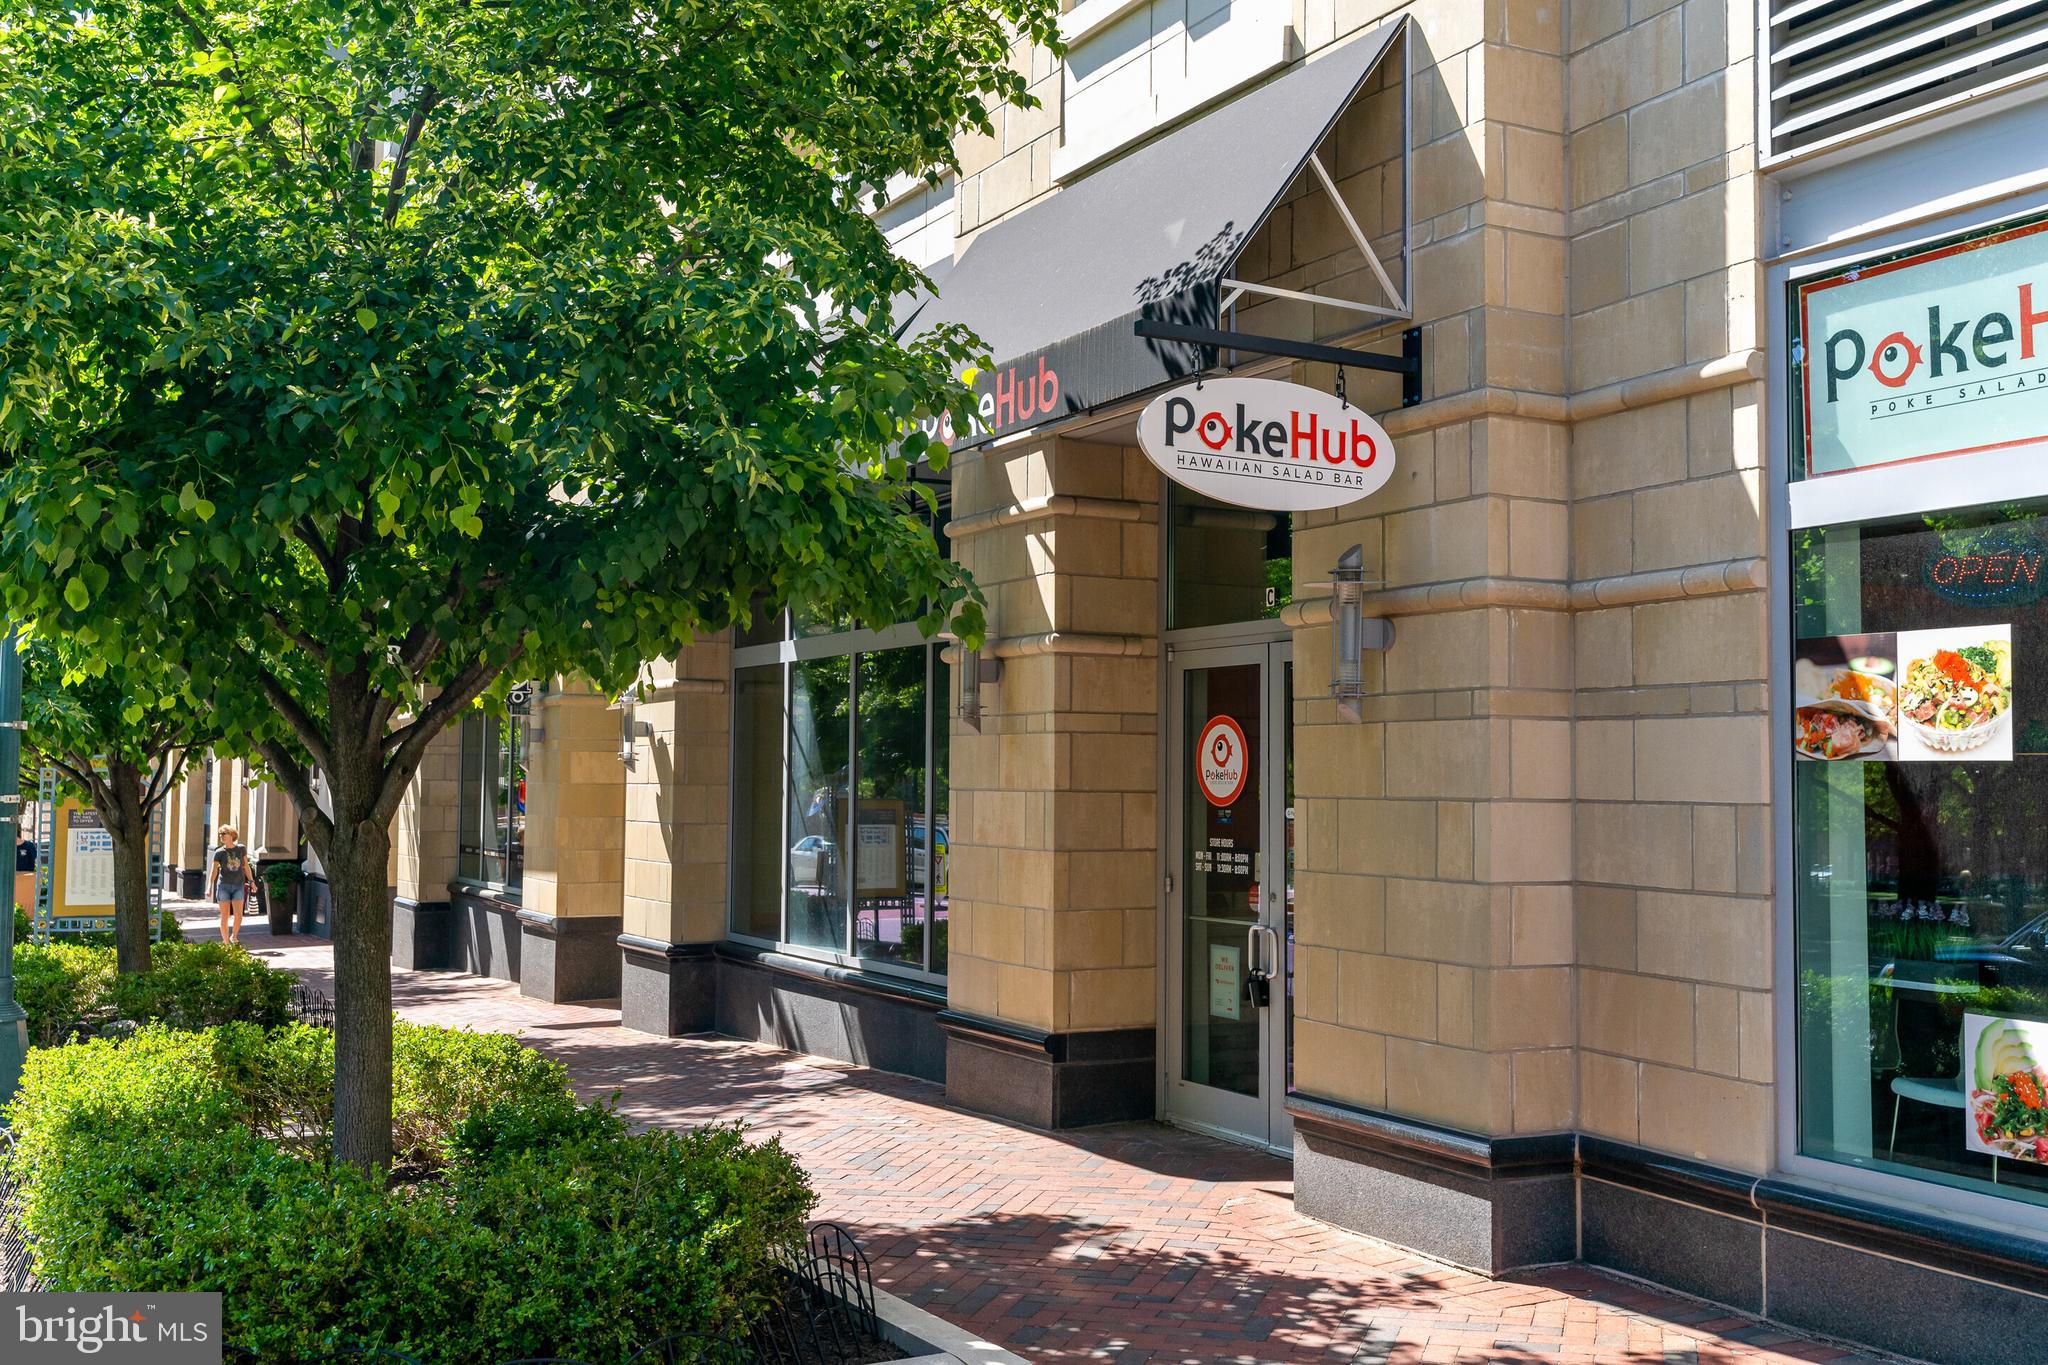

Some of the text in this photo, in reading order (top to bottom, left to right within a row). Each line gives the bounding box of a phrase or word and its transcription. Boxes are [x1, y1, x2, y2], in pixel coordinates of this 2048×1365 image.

[1871, 372, 2046, 415] POKE SALAD
[1177, 454, 1363, 486] HAWAIIAN SALAD BAR
[1932, 555, 2042, 584] OPEN
[1221, 838, 1234, 848] HOURS
